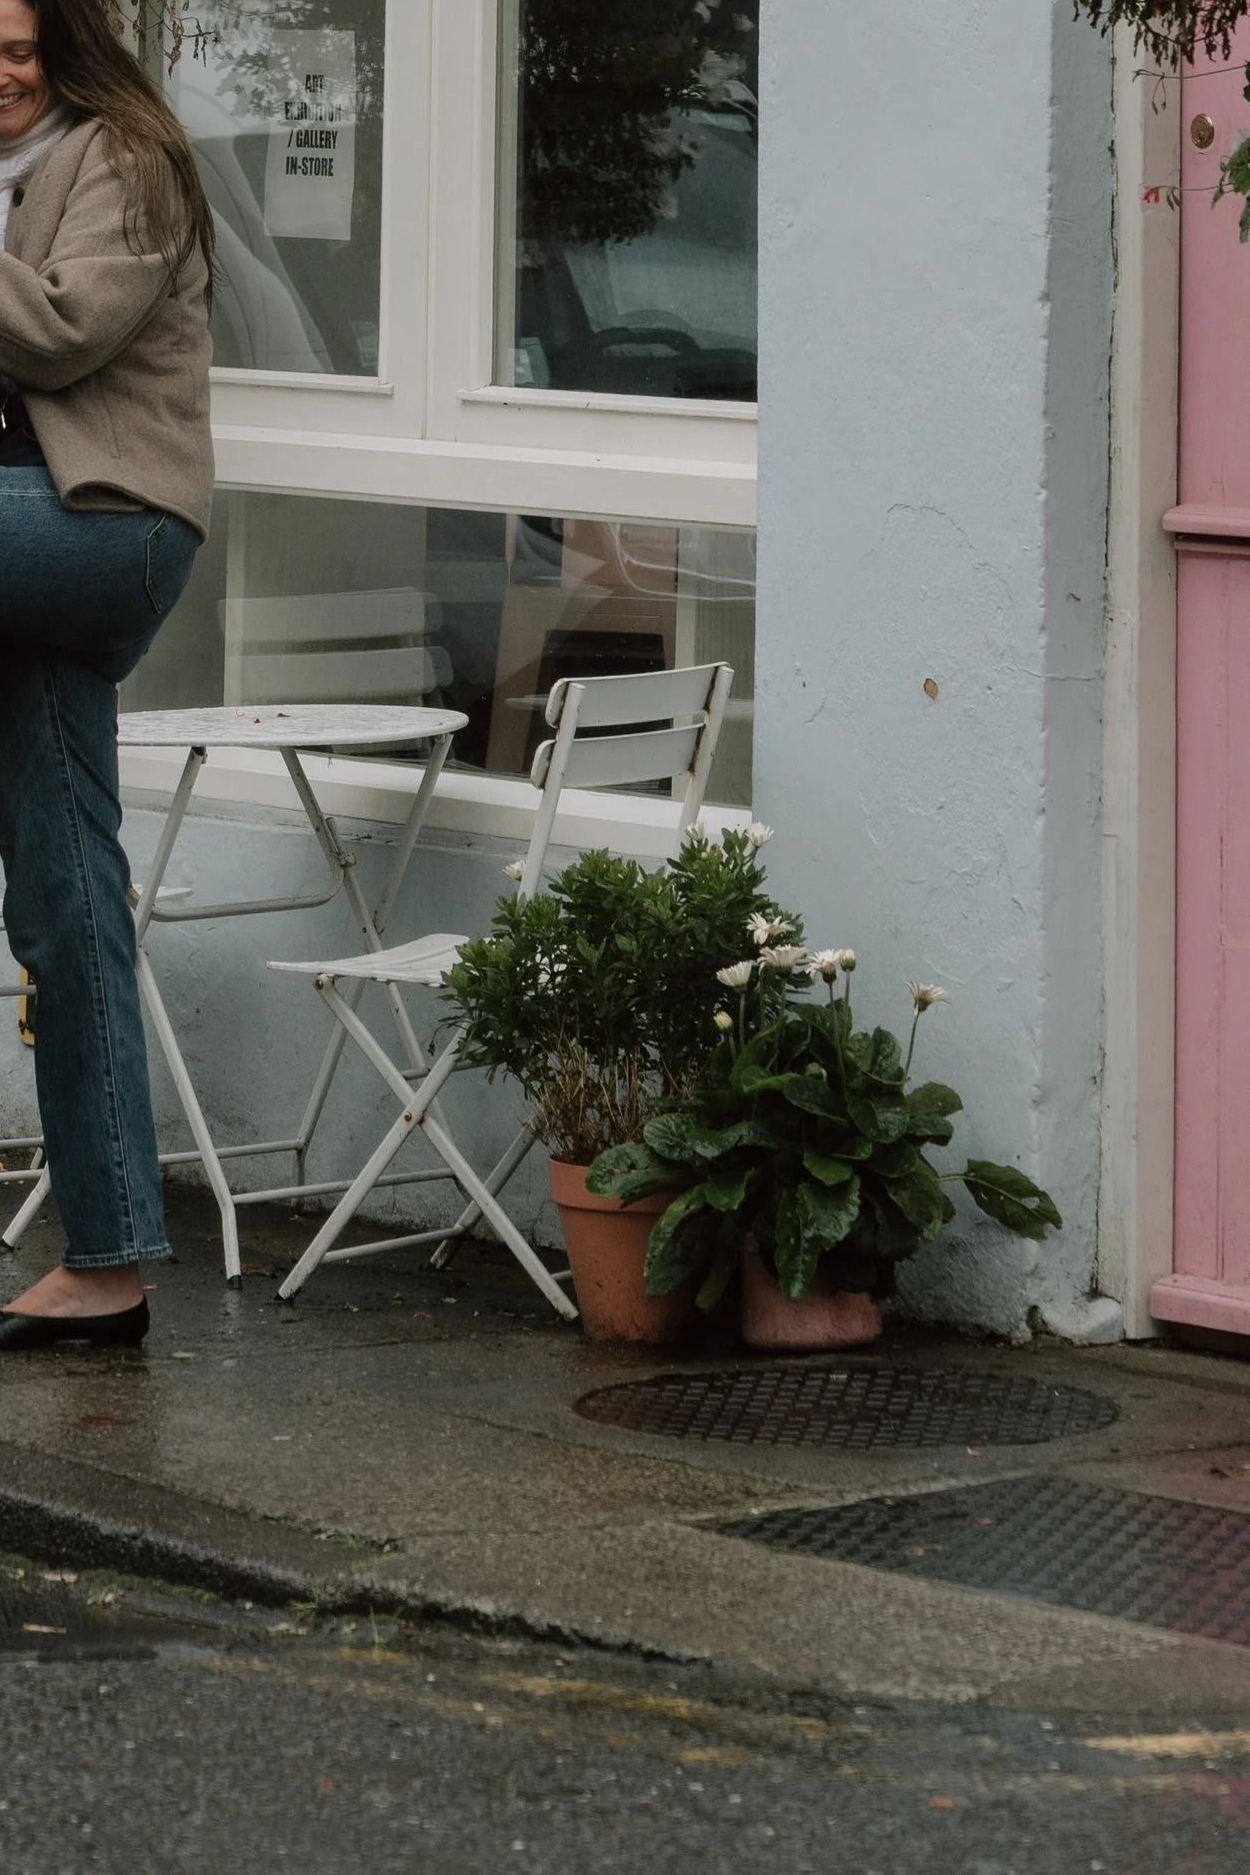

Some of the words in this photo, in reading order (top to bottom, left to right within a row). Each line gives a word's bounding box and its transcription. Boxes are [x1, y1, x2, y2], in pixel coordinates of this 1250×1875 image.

[305, 74, 325, 93] ART
[296, 129, 338, 150] GALLERY
[285, 156, 334, 177] IN-STORE
